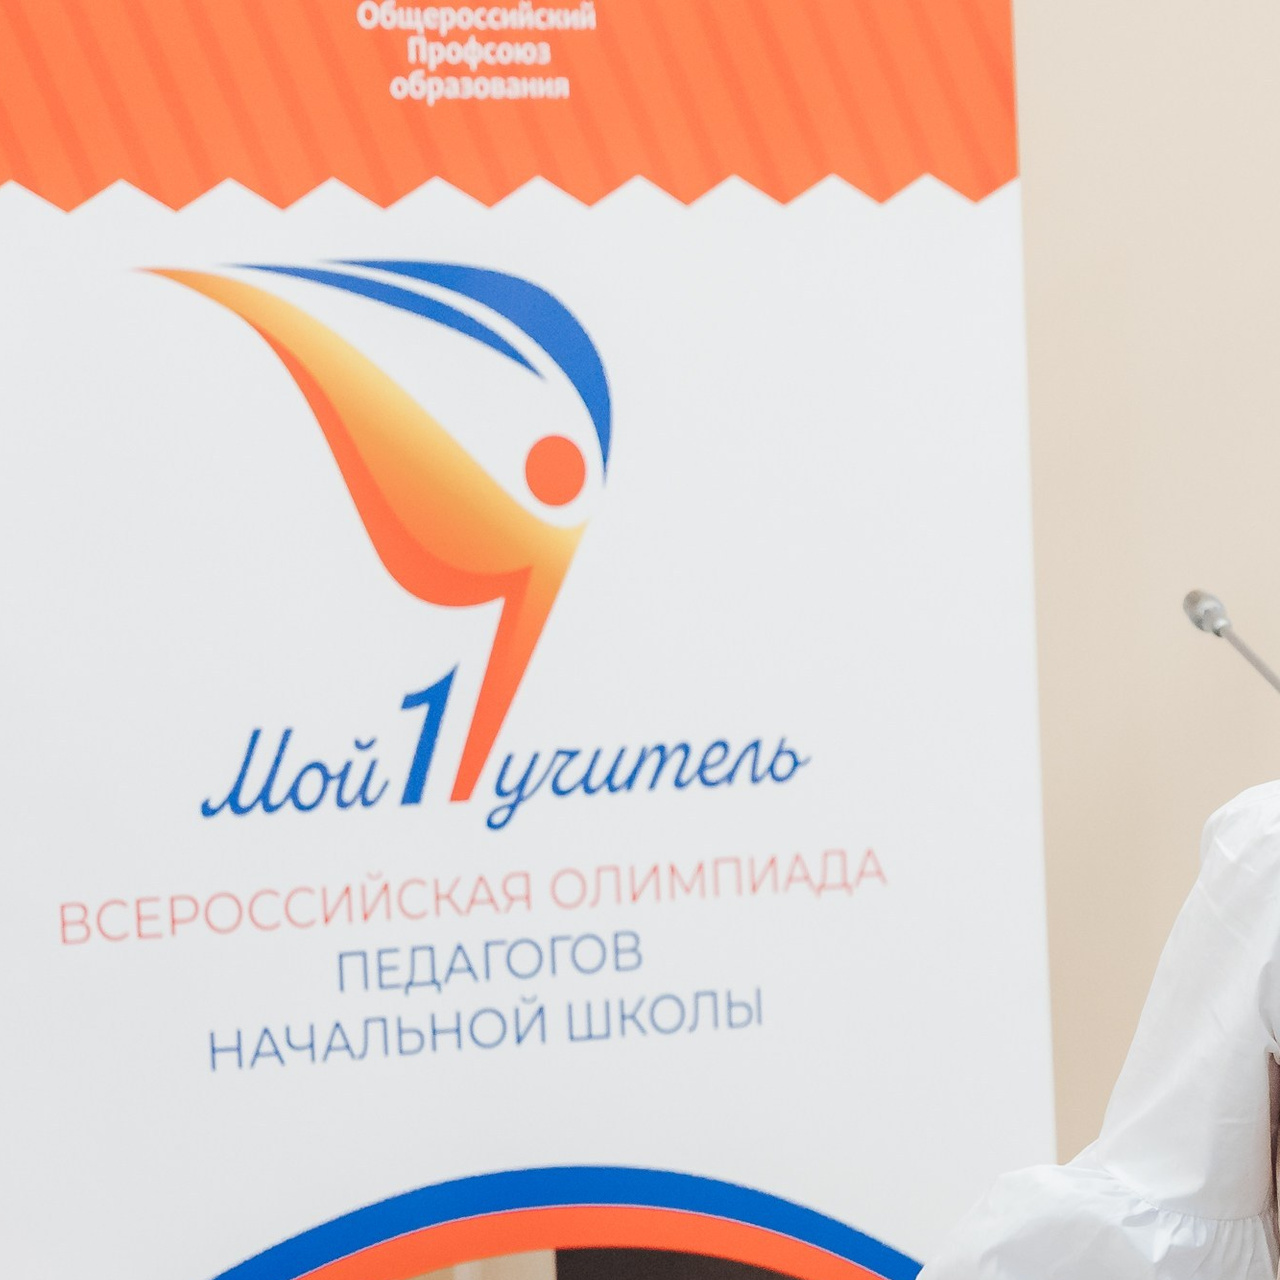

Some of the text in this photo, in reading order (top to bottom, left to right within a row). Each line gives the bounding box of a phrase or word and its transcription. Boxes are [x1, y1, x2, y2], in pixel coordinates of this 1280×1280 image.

[356, 0, 596, 36] Общероссийский
[407, 35, 551, 72] Профсоюз
[389, 69, 570, 107] образования
[201, 664, 812, 830] Мой 1 учитель
[59, 848, 888, 945] ВСЕРОССИЙСКАЯ ОЛИМПИАДА
[337, 930, 643, 996] ПЕДАГОГОВ
[208, 988, 763, 1072] НАЧАЛЬНОЙ ШКОЛЫ
